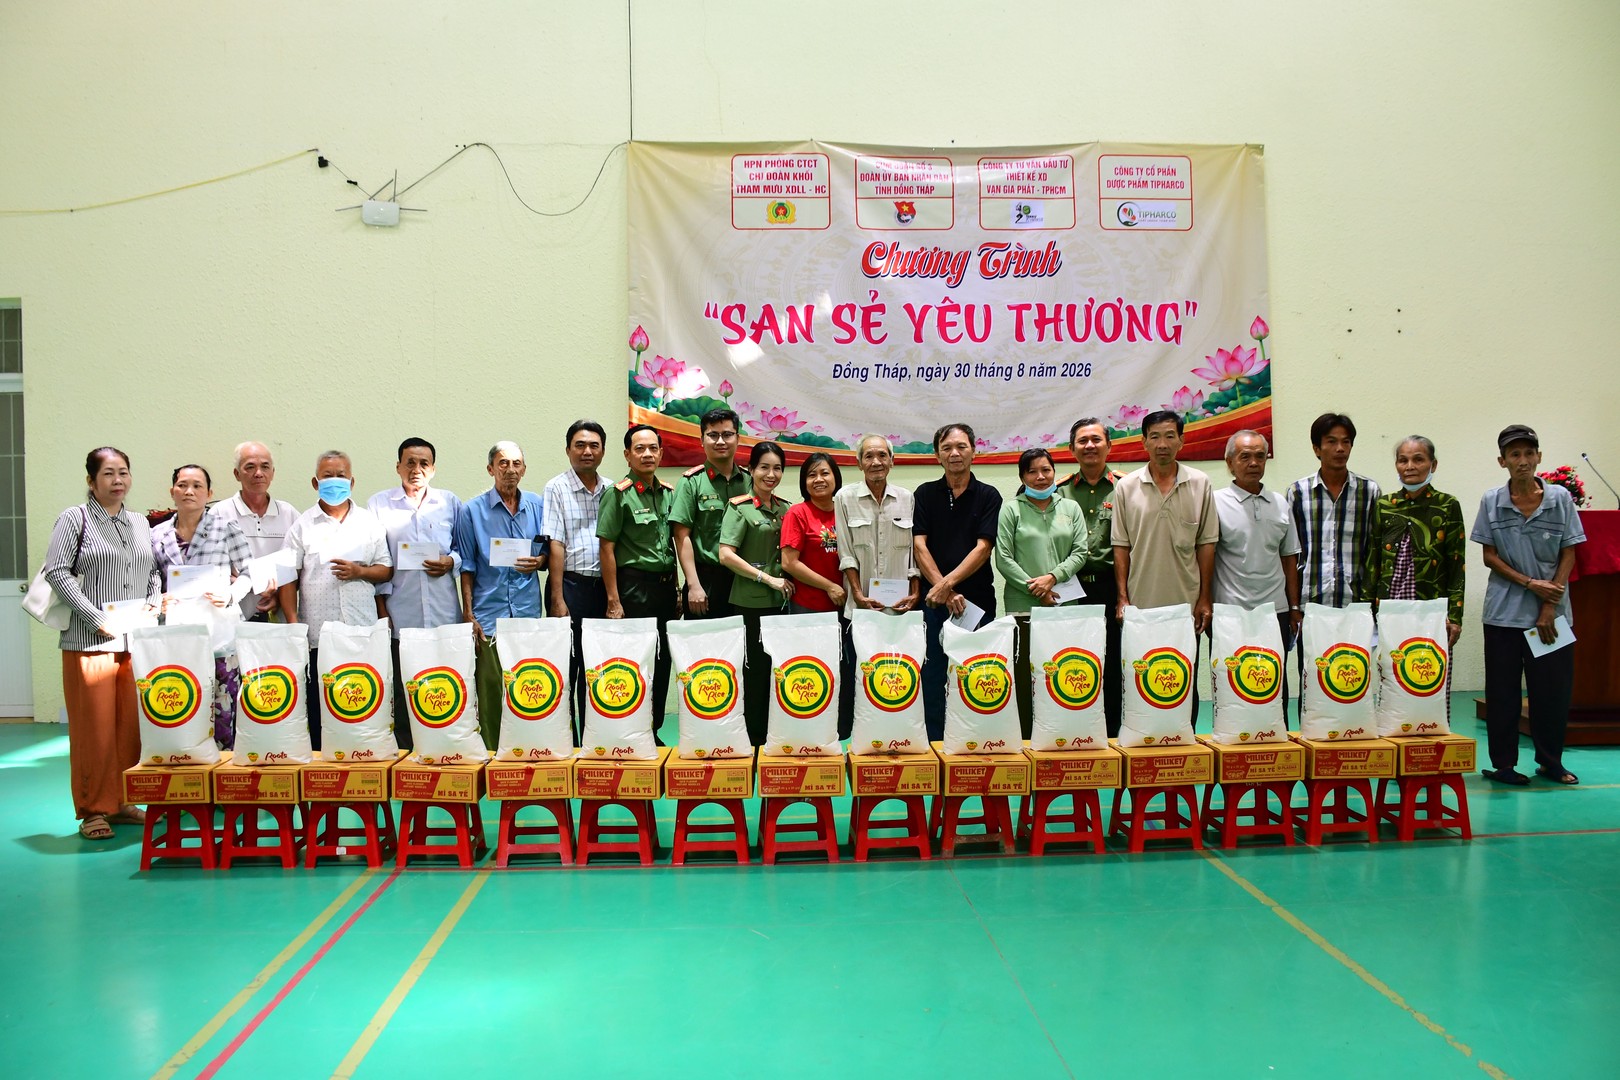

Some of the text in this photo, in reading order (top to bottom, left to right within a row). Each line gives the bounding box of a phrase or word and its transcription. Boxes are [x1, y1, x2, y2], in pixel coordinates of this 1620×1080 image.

[744, 158, 817, 168] HPN PHÒNG CTCT
[983, 161, 1004, 170] CÔNG
[1005, 161, 1015, 169] TY
[1060, 159, 1068, 169] TƯ
[749, 170, 813, 181] CHI ĐOÀN KHỐI
[1114, 164, 1177, 176] CÔNG TY CỔ PHẦN
[860, 171, 881, 182] ĐOÀN
[894, 173, 910, 182] BAN
[1006, 171, 1047, 181] THIẾT KẾ XD
[1106, 176, 1185, 190] DƯỢC PHẨM TIPHARCO
[736, 185, 761, 194] THAM
[763, 184, 783, 194] MƯU
[785, 185, 806, 194] XDLL
[815, 185, 826, 194] HC
[875, 183, 935, 195] TỈNH ĐỒNG THÁP
[986, 184, 1002, 196] VẠN
[1003, 185, 1015, 194] GIA
[1016, 183, 1035, 194] PHÁT
[1042, 185, 1066, 194] TPHCM
[1138, 210, 1177, 219] TIPHARCO
[861, 240, 1063, 289] Chương Trình
[831, 289, 889, 346] SẺ
[902, 296, 992, 345] YÊU
[832, 362, 1092, 382] Đồng Tháp, ngày 30 tháng 8 năm 2026
[1411, 663, 1433, 673] Roots
[1154, 673, 1176, 685] Roots
[1248, 669, 1269, 680] Roots
[1337, 669, 1358, 679] Roots
[1420, 670, 1436, 681] Rice
[880, 677, 902, 689] Roots
[976, 678, 998, 690] Roots
[1065, 674, 1087, 686] Roots
[1256, 677, 1272, 688] Rice
[1345, 676, 1361, 687] Rice
[520, 684, 543, 695] Roots
[604, 683, 627, 694] Roots
[698, 683, 721, 695] Roots
[791, 682, 814, 694] Roots
[889, 684, 907, 695] Rice
[984, 686, 1002, 698] Rice
[1073, 682, 1090, 693] Rice
[1162, 681, 1180, 692] Rice
[157, 692, 180, 703] Roots
[255, 688, 278, 700] Roots
[340, 687, 363, 699] Roots
[425, 692, 447, 703] Roots
[529, 691, 546, 702] Rice
[611, 691, 630, 702] Rice
[707, 691, 725, 702] Rice
[800, 690, 818, 701] Rice
[165, 700, 183, 710] Rice
[262, 696, 281, 708] Rice
[348, 695, 367, 707] Rice
[433, 698, 450, 710] Rice
[1417, 722, 1438, 732] Roots
[1255, 731, 1276, 740] Roots
[1344, 728, 1364, 738] Roots
[889, 740, 911, 749] Roots
[983, 740, 1005, 750] Roots
[1071, 736, 1093, 746] Roots
[1159, 735, 1181, 744] Roots
[351, 749, 373, 759] Roots
[530, 748, 551, 758] Roots
[612, 746, 634, 755] Roots
[711, 746, 733, 756] Roots
[799, 746, 822, 755] Roots
[1338, 751, 1367, 759] MILIKET
[265, 752, 287, 761] Roots
[441, 753, 462, 763] Roots
[1155, 757, 1183, 766] MILIKET
[1246, 754, 1275, 762] MILIKET
[1061, 761, 1090, 769] MILIKET
[309, 772, 339, 780] MILIKET
[401, 772, 431, 781] MILIKET
[494, 771, 525, 779] MILIKET
[583, 770, 614, 778] MILIKET
[673, 770, 704, 778] MILIKET
[766, 768, 797, 777] MILIKET
[863, 767, 893, 776] MILIKET
[955, 767, 986, 776] MILIKET
[132, 776, 162, 784] MILIKET
[222, 775, 252, 783] MILIKET
